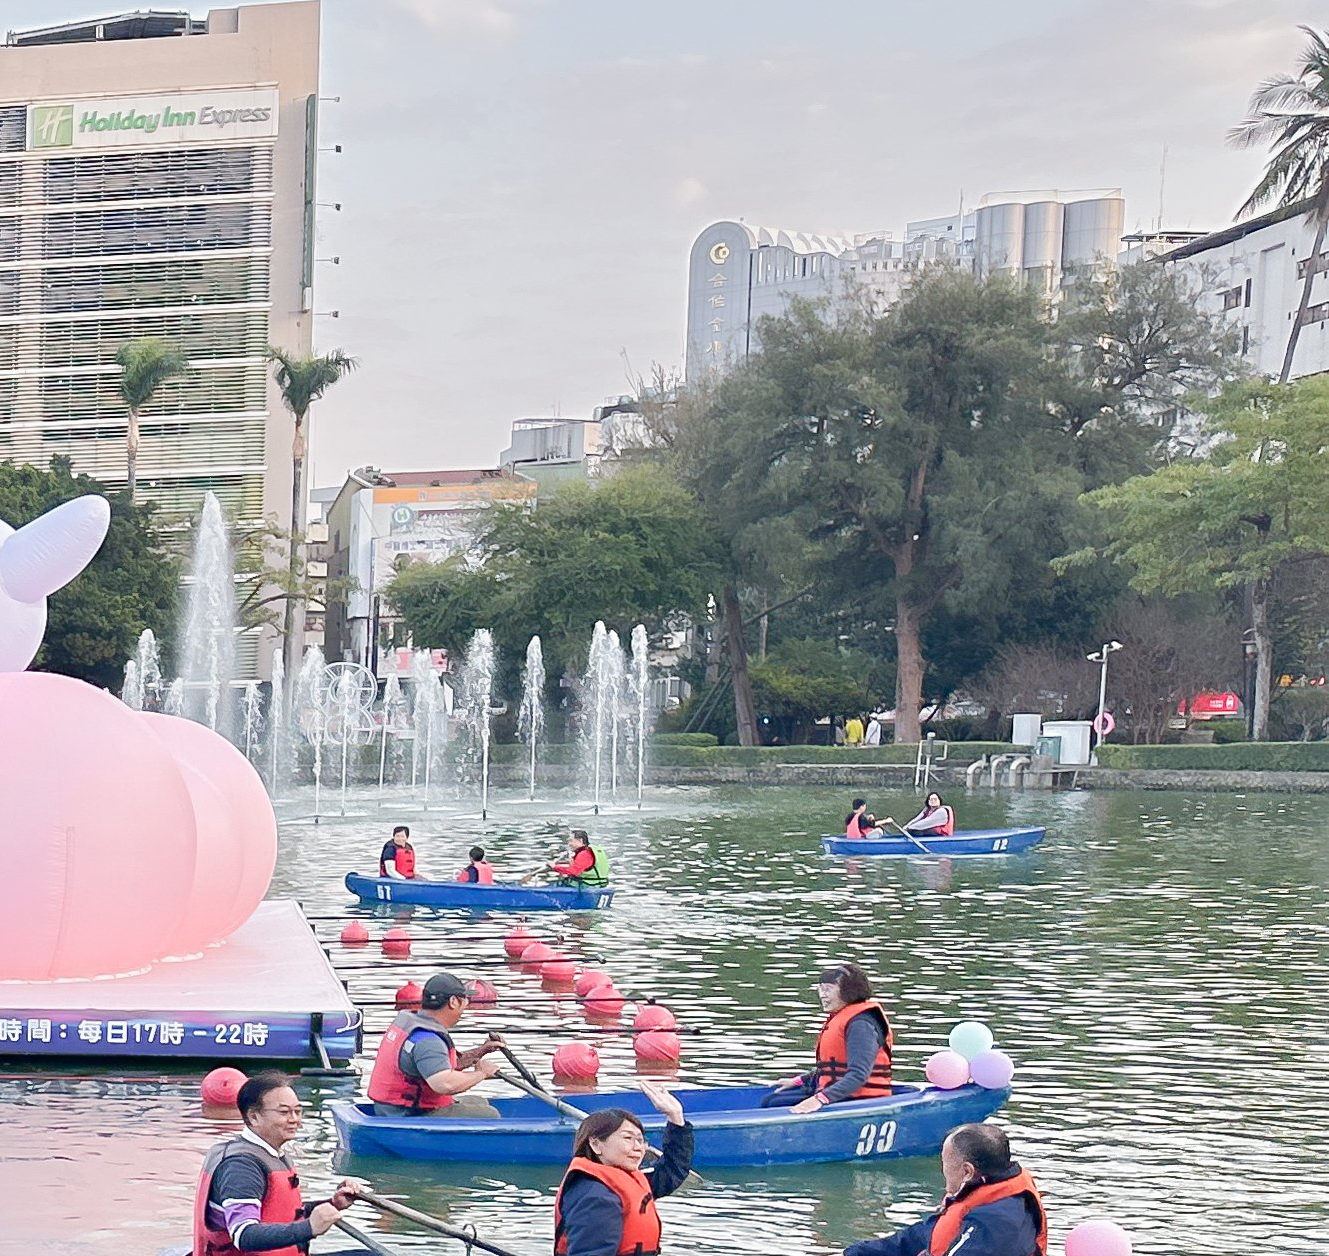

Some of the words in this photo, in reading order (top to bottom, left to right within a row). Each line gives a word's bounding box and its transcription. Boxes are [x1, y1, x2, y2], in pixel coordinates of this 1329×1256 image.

[79, 109, 160, 133] Holiday
[161, 106, 196, 127] Inn
[198, 105, 271, 128] Express
[855, 1120, 898, 1156] 33
